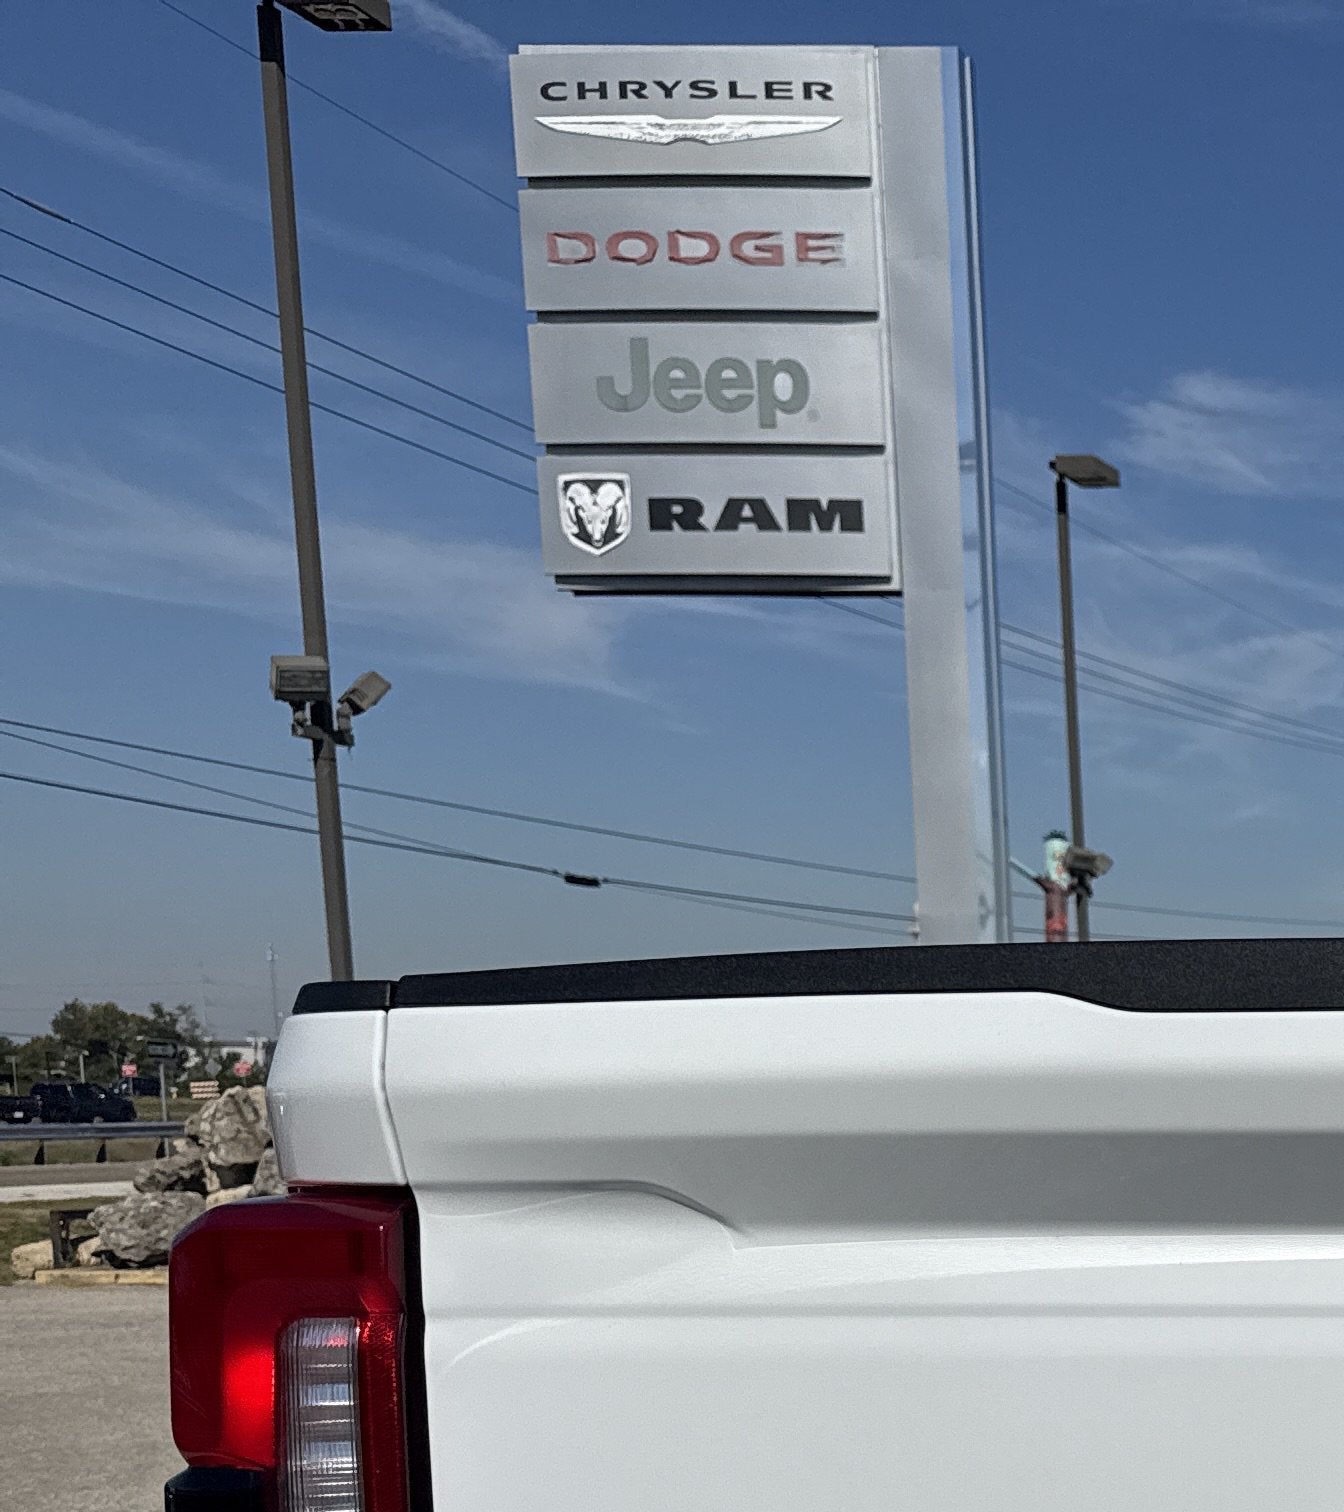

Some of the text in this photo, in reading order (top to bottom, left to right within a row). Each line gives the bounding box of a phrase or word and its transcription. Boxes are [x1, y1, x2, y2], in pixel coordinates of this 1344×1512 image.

[539, 79, 834, 101] CHRYSLER
[546, 230, 844, 267] DODGE
[596, 337, 811, 429] Jeep
[648, 497, 865, 533] RAM
